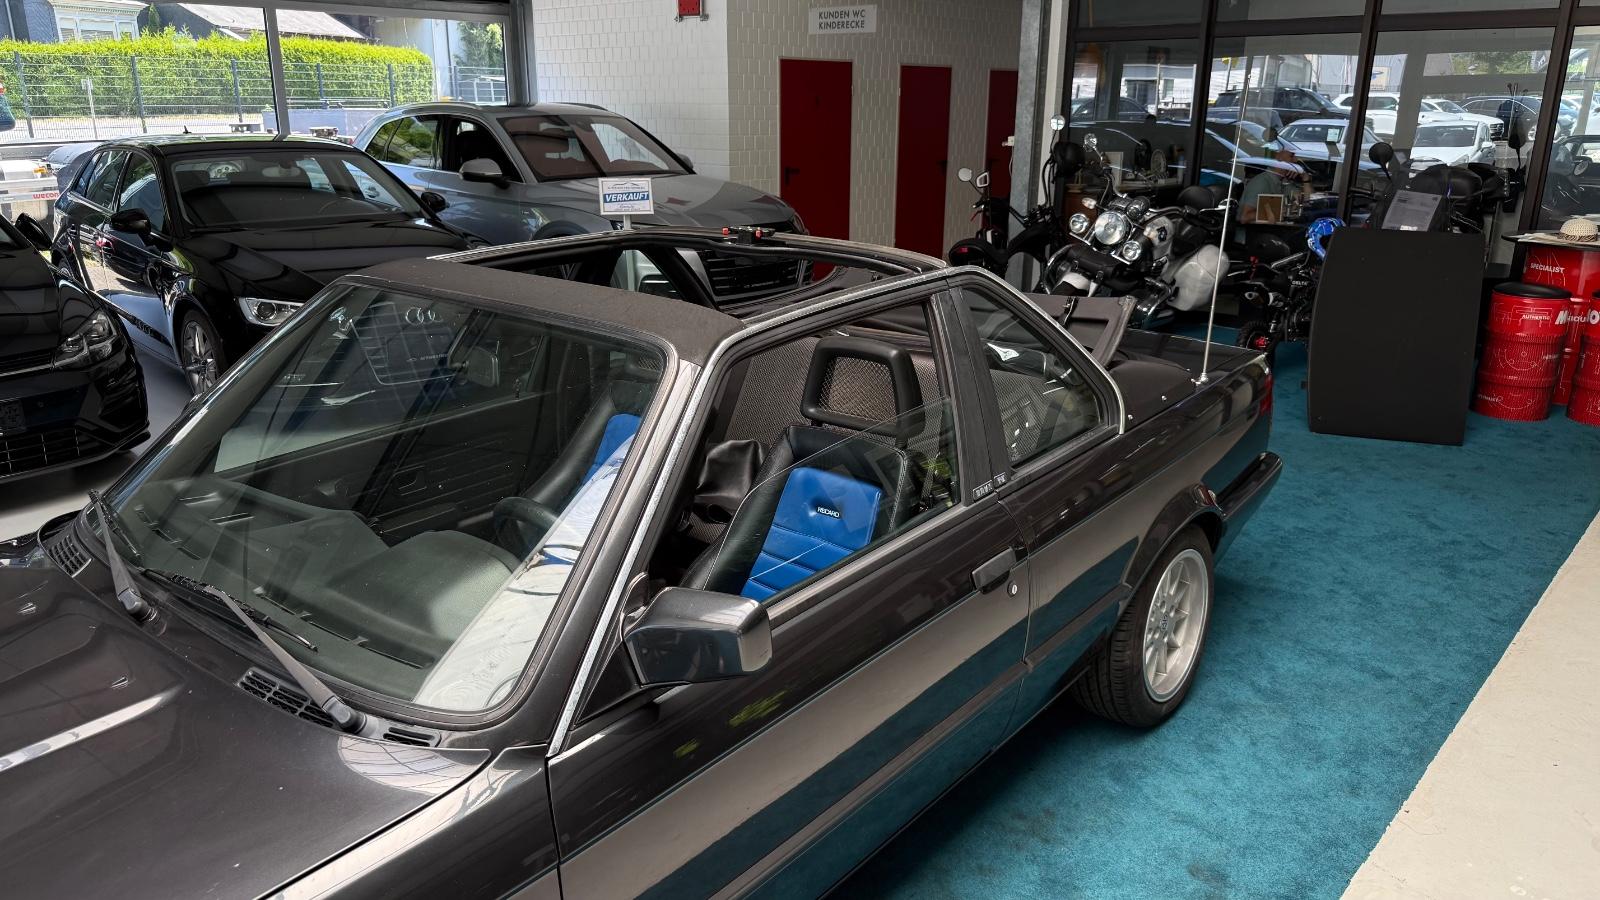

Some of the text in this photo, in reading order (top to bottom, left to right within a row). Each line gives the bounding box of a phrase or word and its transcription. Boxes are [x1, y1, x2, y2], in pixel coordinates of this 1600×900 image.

[818, 9, 866, 20] KUNDEN WC
[818, 20, 865, 30] KINDERECKE
[605, 192, 648, 202] VERKAUFT
[1530, 262, 1565, 273] SPECIALIST
[817, 506, 840, 518] RECARO
